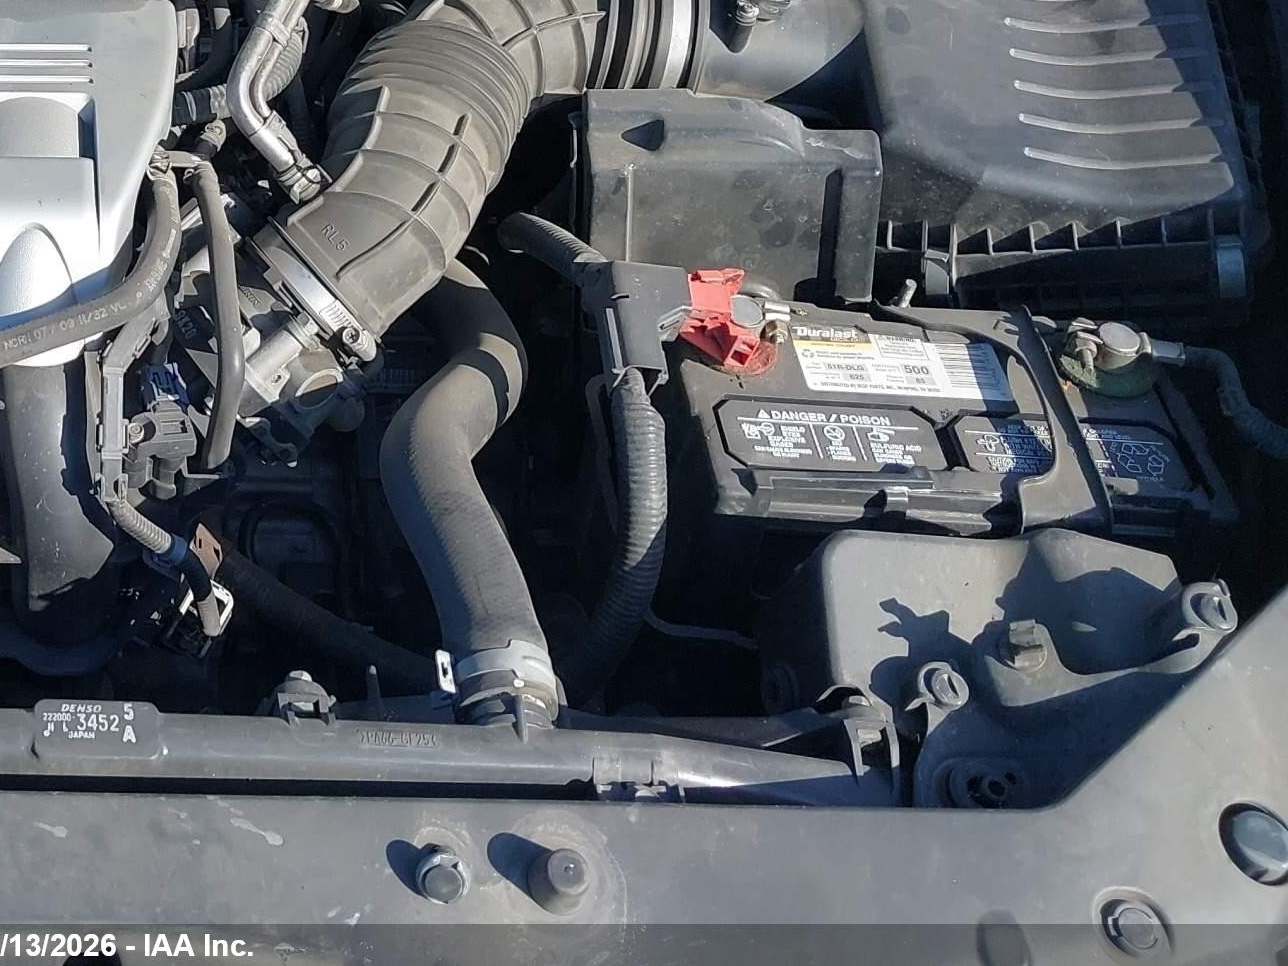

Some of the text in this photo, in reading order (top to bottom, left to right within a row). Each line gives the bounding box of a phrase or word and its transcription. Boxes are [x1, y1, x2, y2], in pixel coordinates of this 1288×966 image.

[792, 326, 858, 339] Duralast
[903, 363, 930, 376] 500
[771, 409, 827, 422] DANGER
[839, 414, 891, 426] POISON
[61, 703, 134, 721] DENSO 5
[68, 730, 96, 739] JAPAN
[122, 724, 137, 744] A
